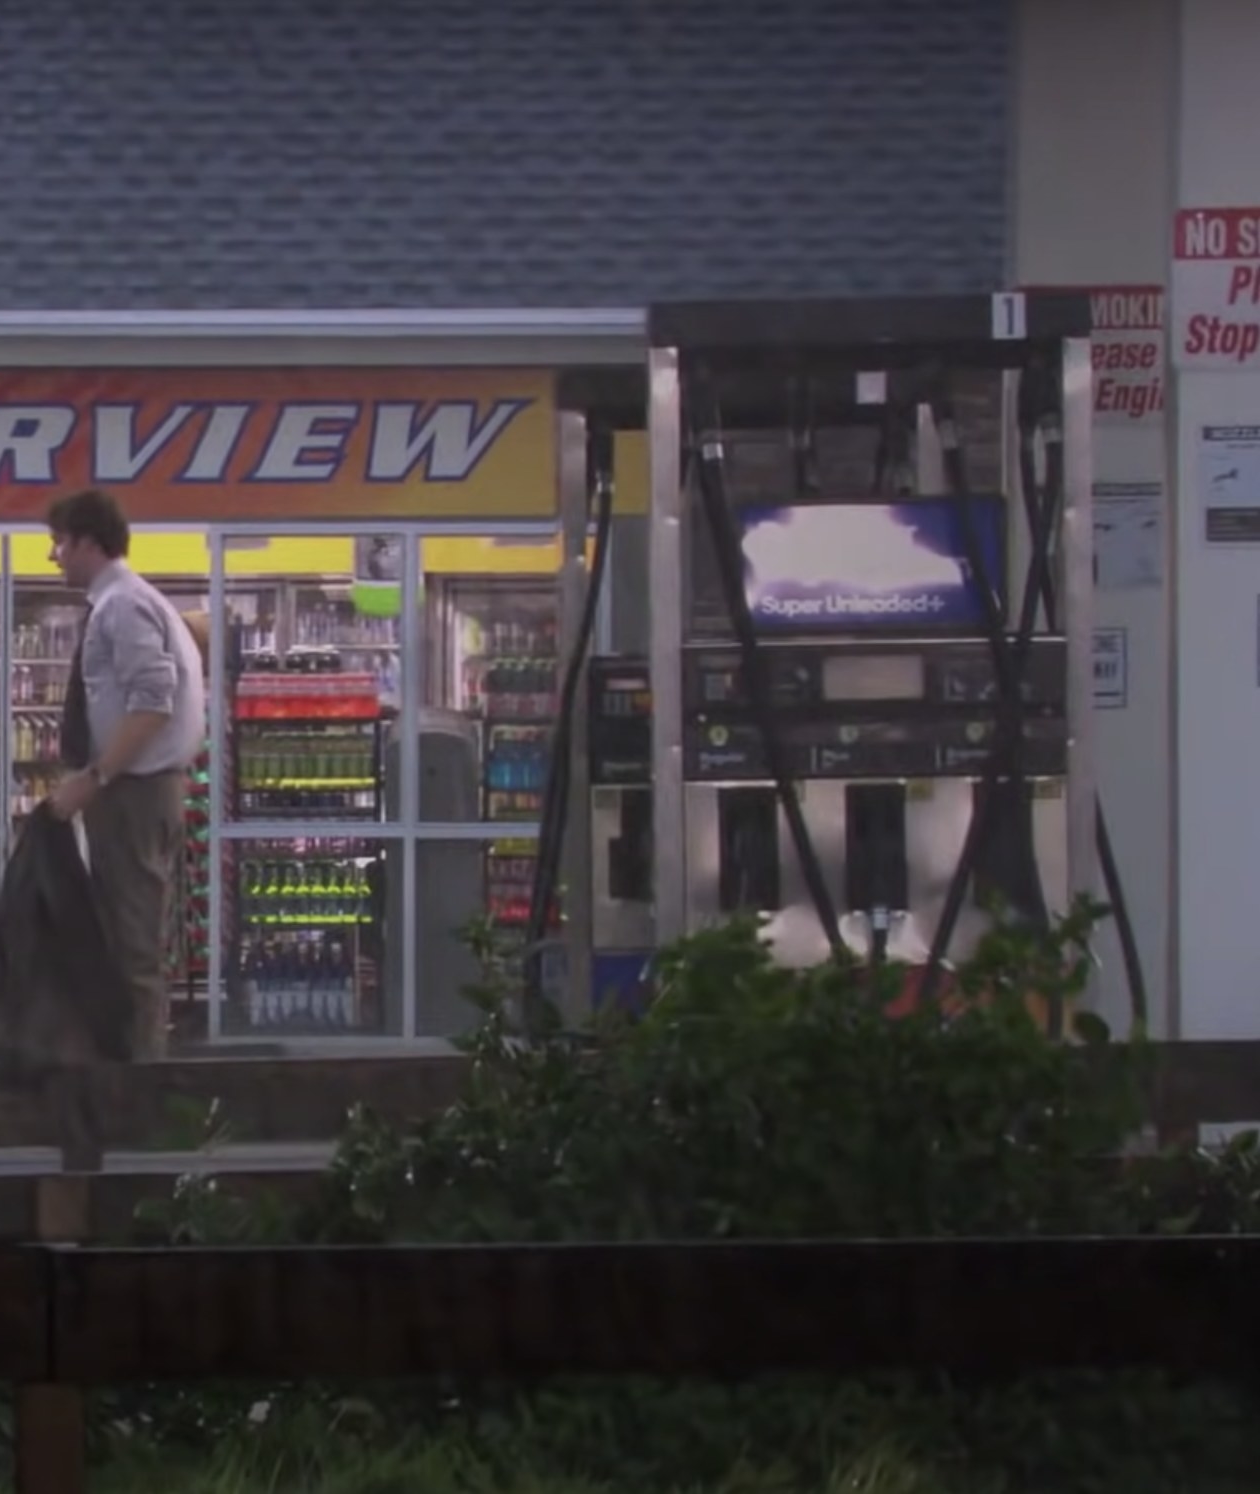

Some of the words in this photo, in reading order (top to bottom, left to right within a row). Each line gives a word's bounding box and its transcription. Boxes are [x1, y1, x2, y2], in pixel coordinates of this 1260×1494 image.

[1185, 219, 1226, 256] NO
[1236, 218, 1260, 256] S
[1003, 296, 1014, 336] 1
[1185, 313, 1260, 362] Stop
[1094, 377, 1163, 418] Engi
[761, 595, 822, 617] Super
